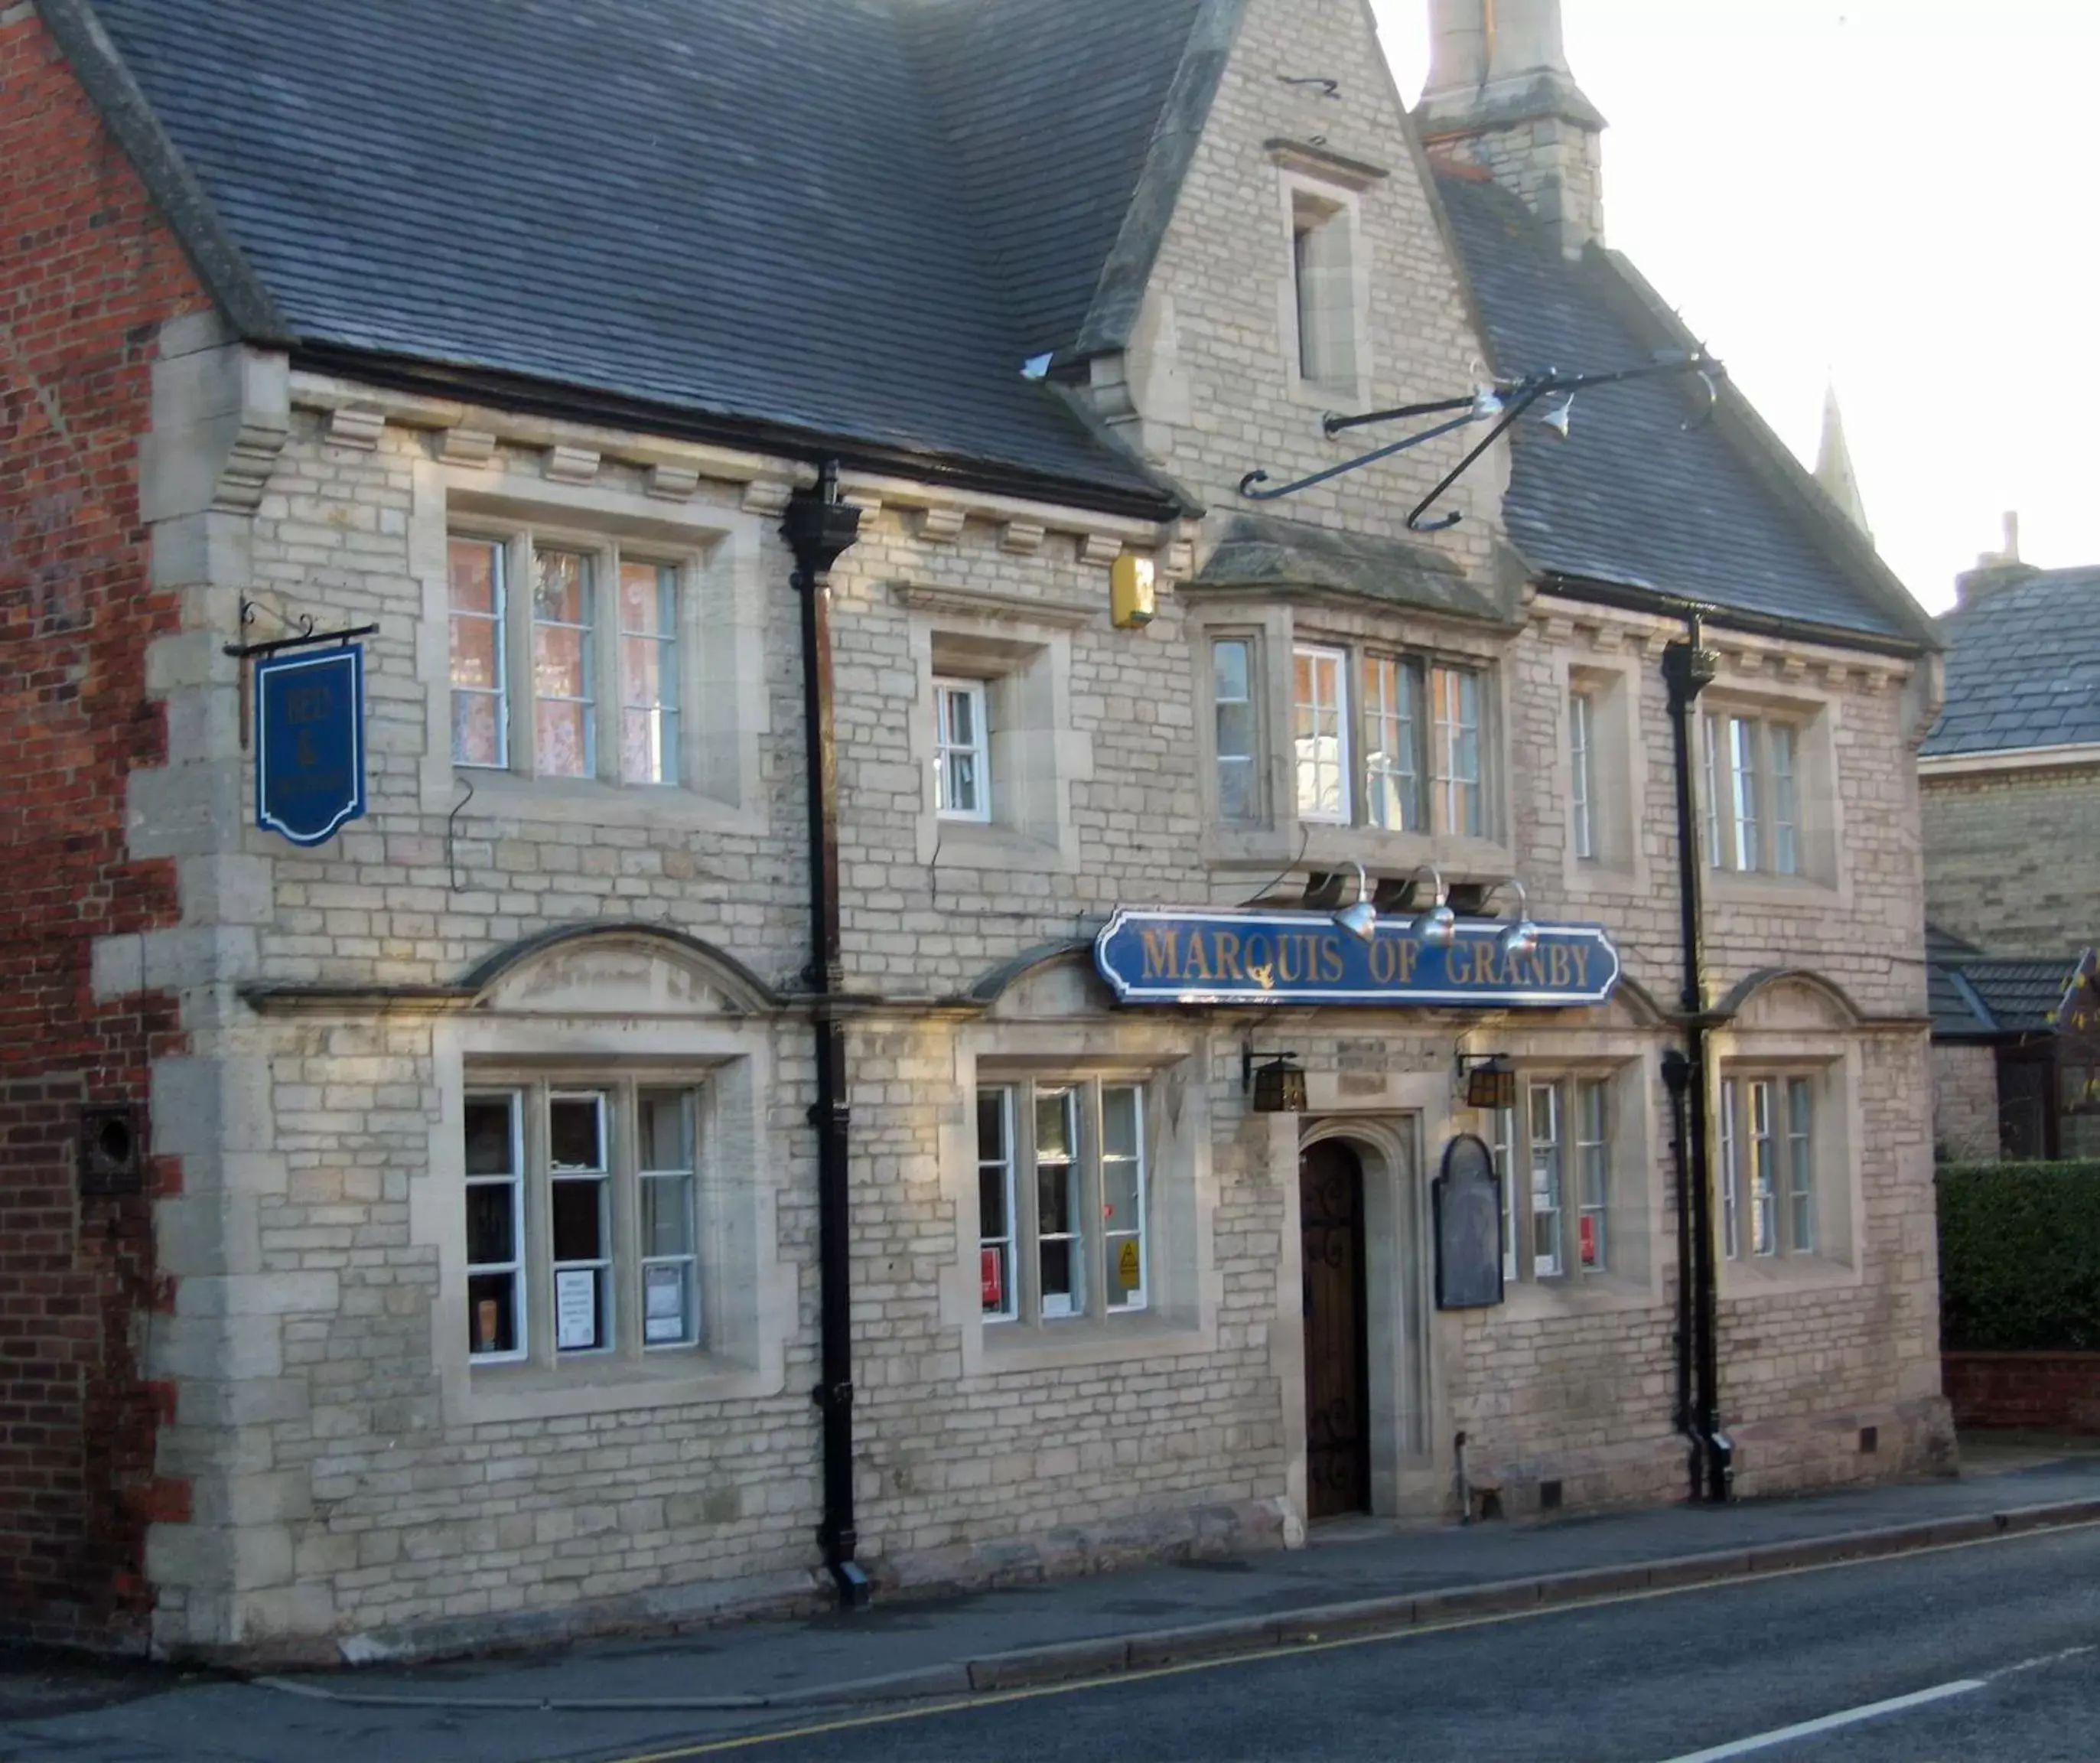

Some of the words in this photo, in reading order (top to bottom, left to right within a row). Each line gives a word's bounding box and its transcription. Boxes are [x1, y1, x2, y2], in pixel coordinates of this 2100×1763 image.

[1141, 928, 1343, 989] MARQUIS
[1368, 935, 1419, 984] OF
[1445, 938, 1590, 987] GRANBY
